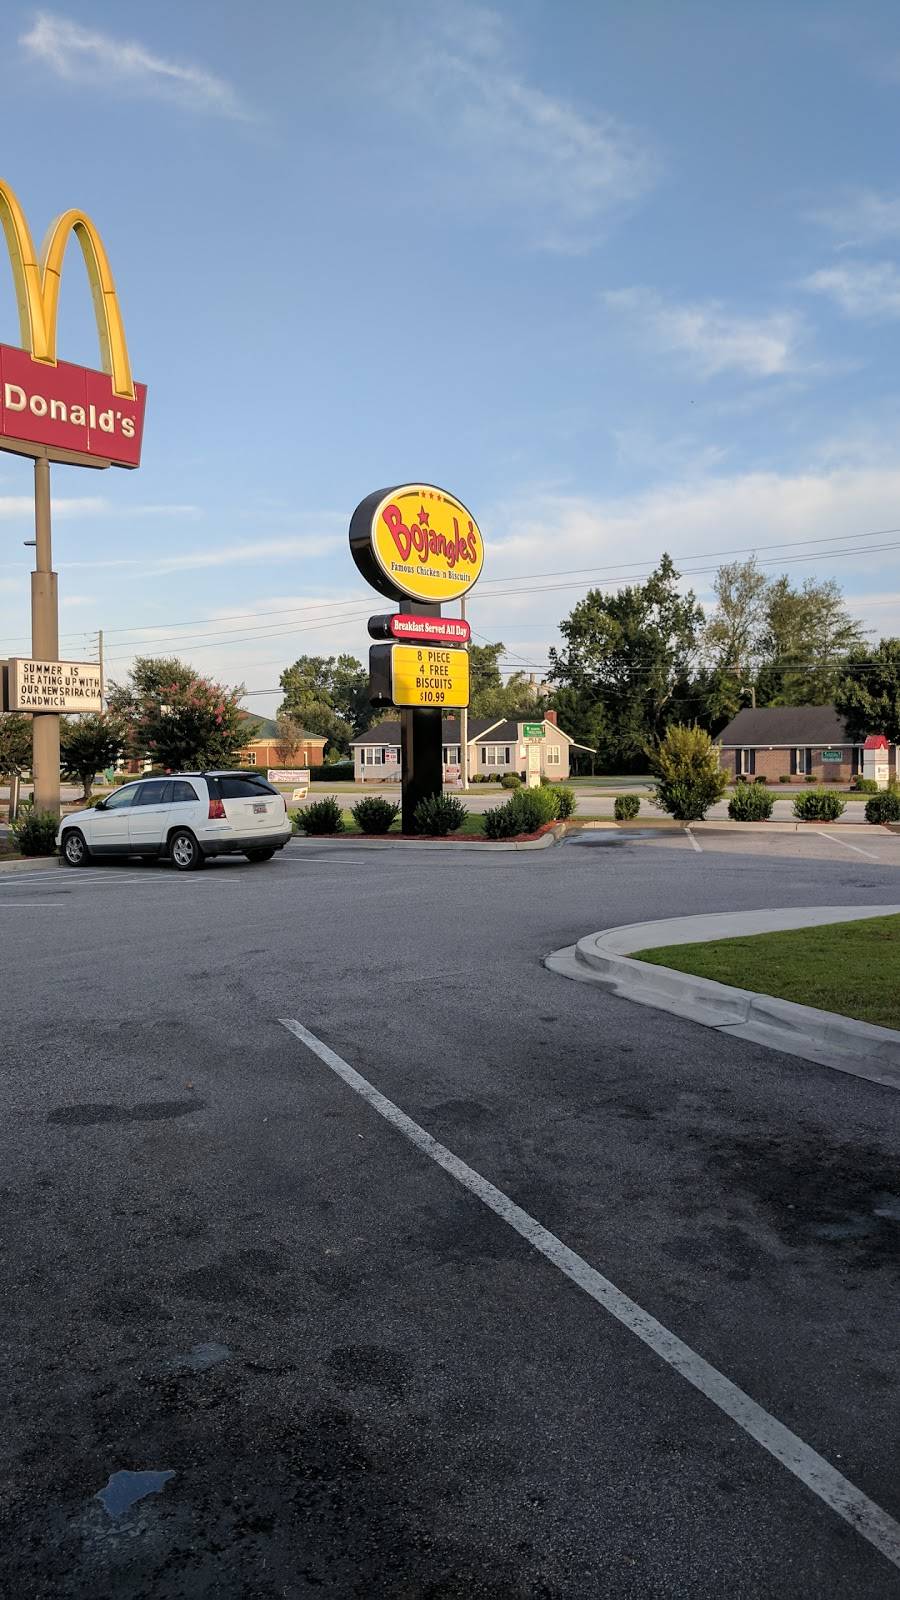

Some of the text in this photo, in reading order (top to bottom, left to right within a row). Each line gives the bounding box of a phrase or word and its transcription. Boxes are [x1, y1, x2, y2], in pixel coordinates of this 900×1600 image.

[391, 562, 415, 573] Famous
[416, 566, 440, 577] Chicken
[448, 570, 471, 581] Biscuits
[394, 619, 467, 637] Breakfast Served All Day
[417, 650, 451, 664] 8 PIECE
[23, 663, 79, 677] SUMMER IS
[419, 664, 449, 676] 4 FREE
[65, 679, 77, 687] UP
[78, 678, 99, 688] WITH
[416, 677, 453, 690] BISCUITS
[21, 685, 39, 695] OUR
[20, 695, 66, 706] SANDWICH
[420, 691, 445, 702] $10.99
